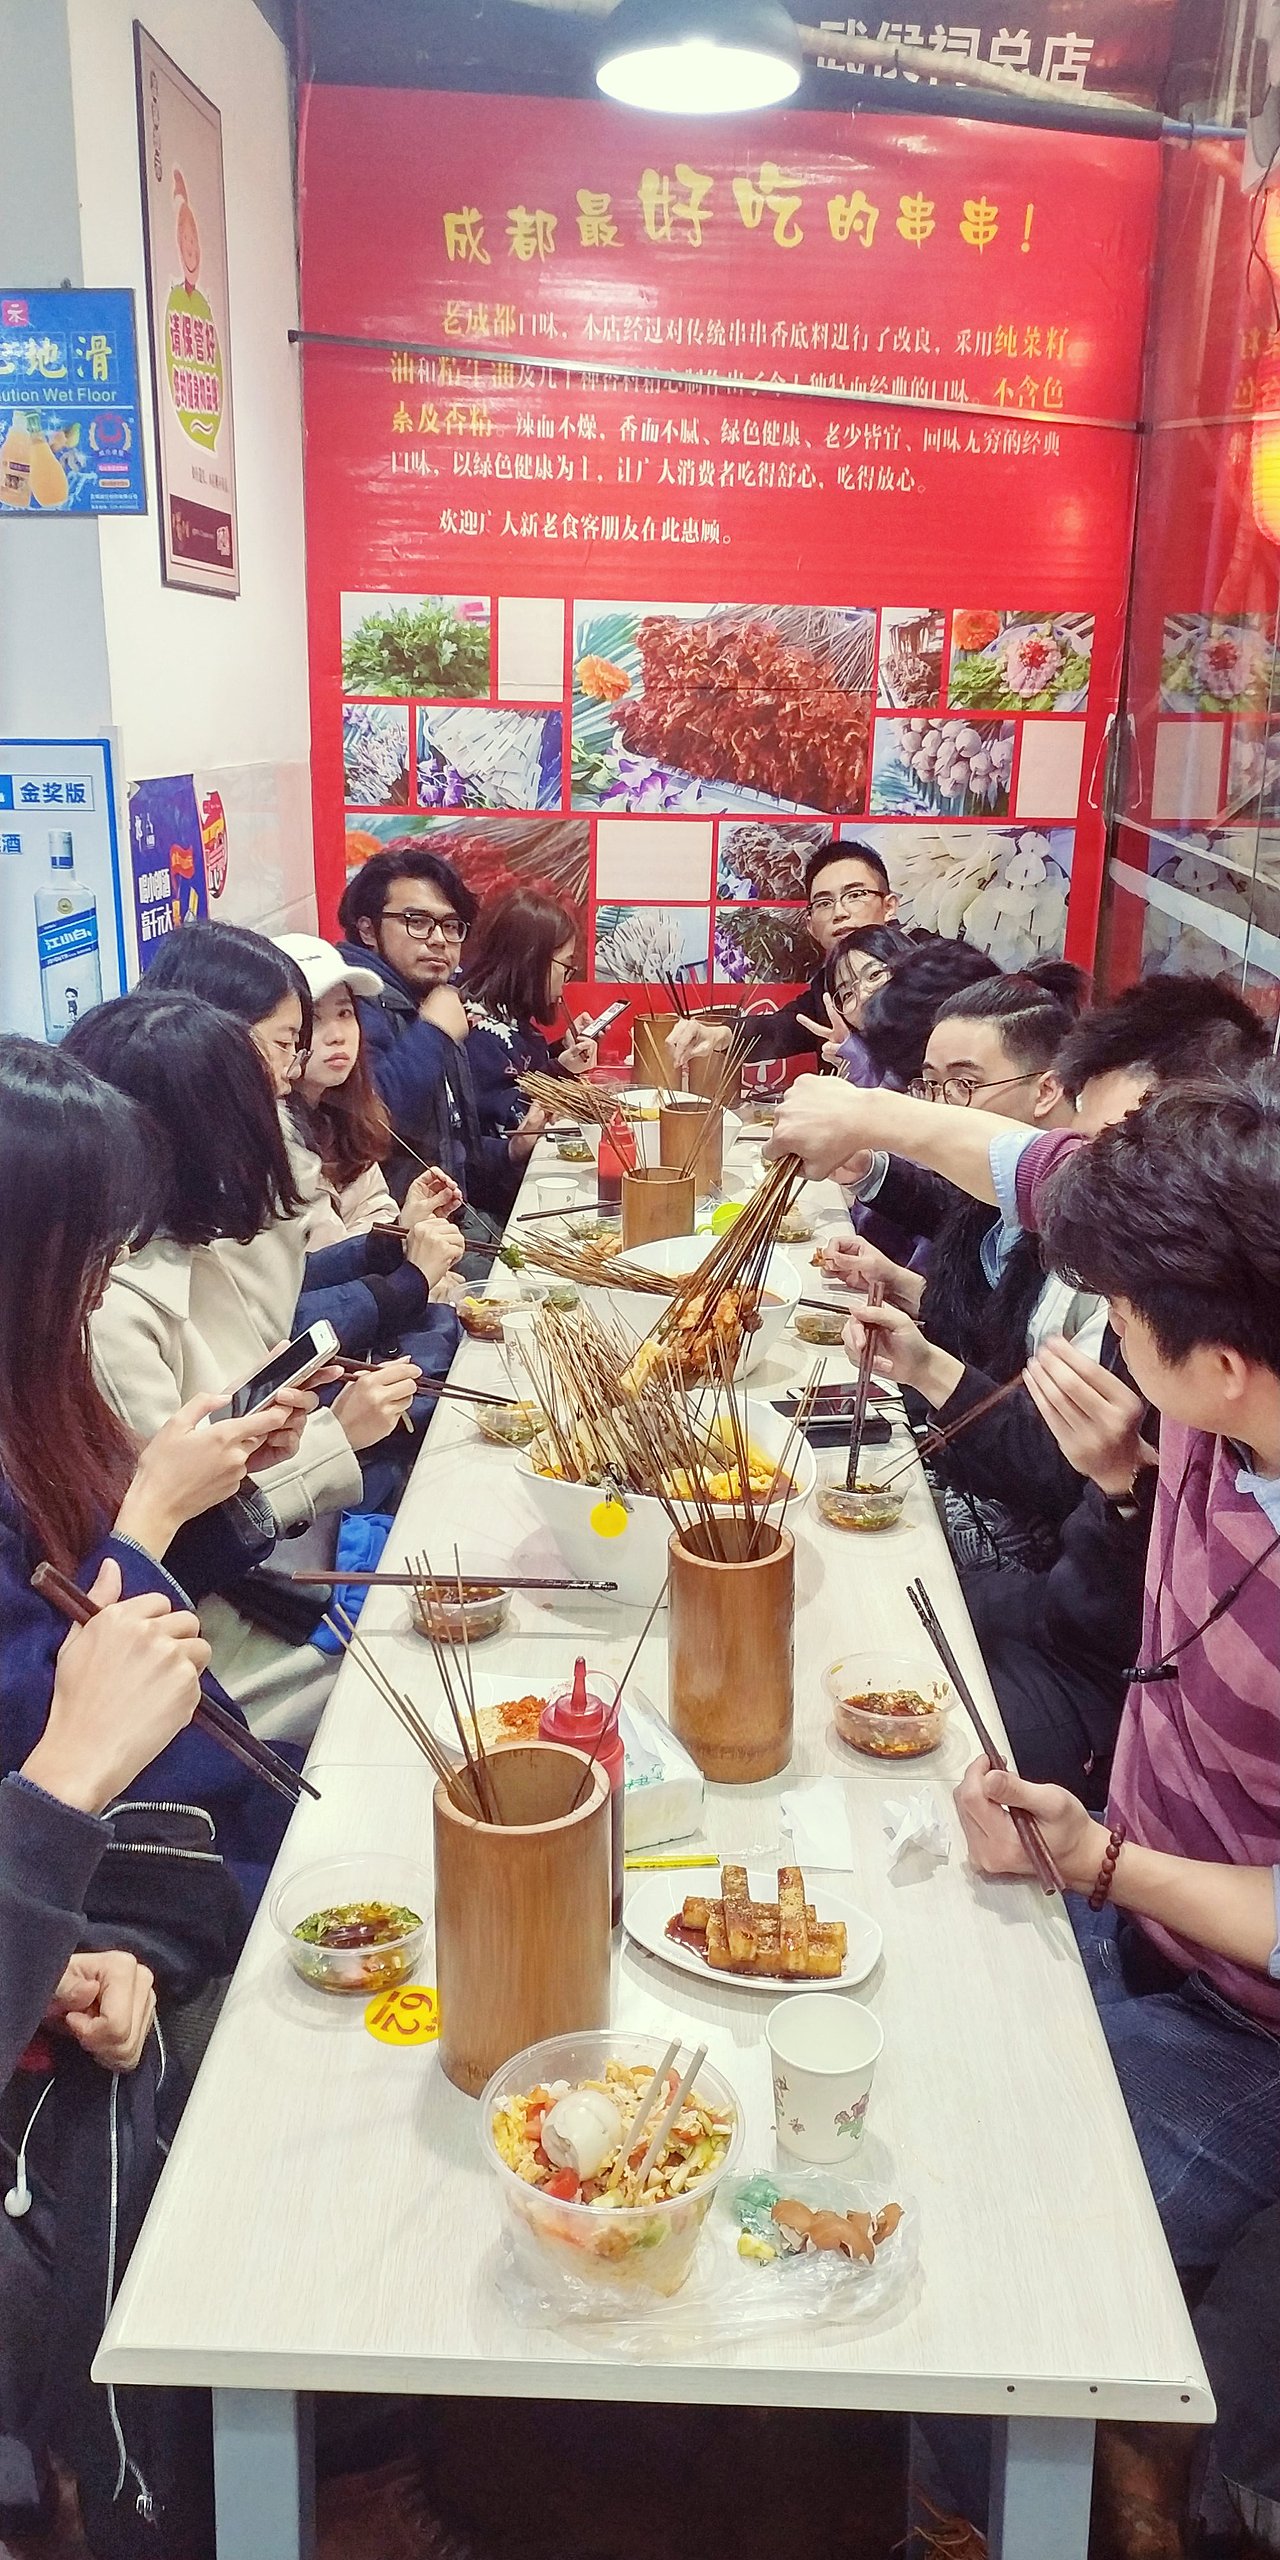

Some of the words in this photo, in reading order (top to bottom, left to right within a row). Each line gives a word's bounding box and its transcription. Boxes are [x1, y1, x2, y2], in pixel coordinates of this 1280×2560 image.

[0, 388, 39, 402] ution
[43, 387, 73, 401] Wet
[77, 387, 117, 401] Floor
[20, 782, 86, 803] 金奖版
[44, 928, 92, 951] 江小白
